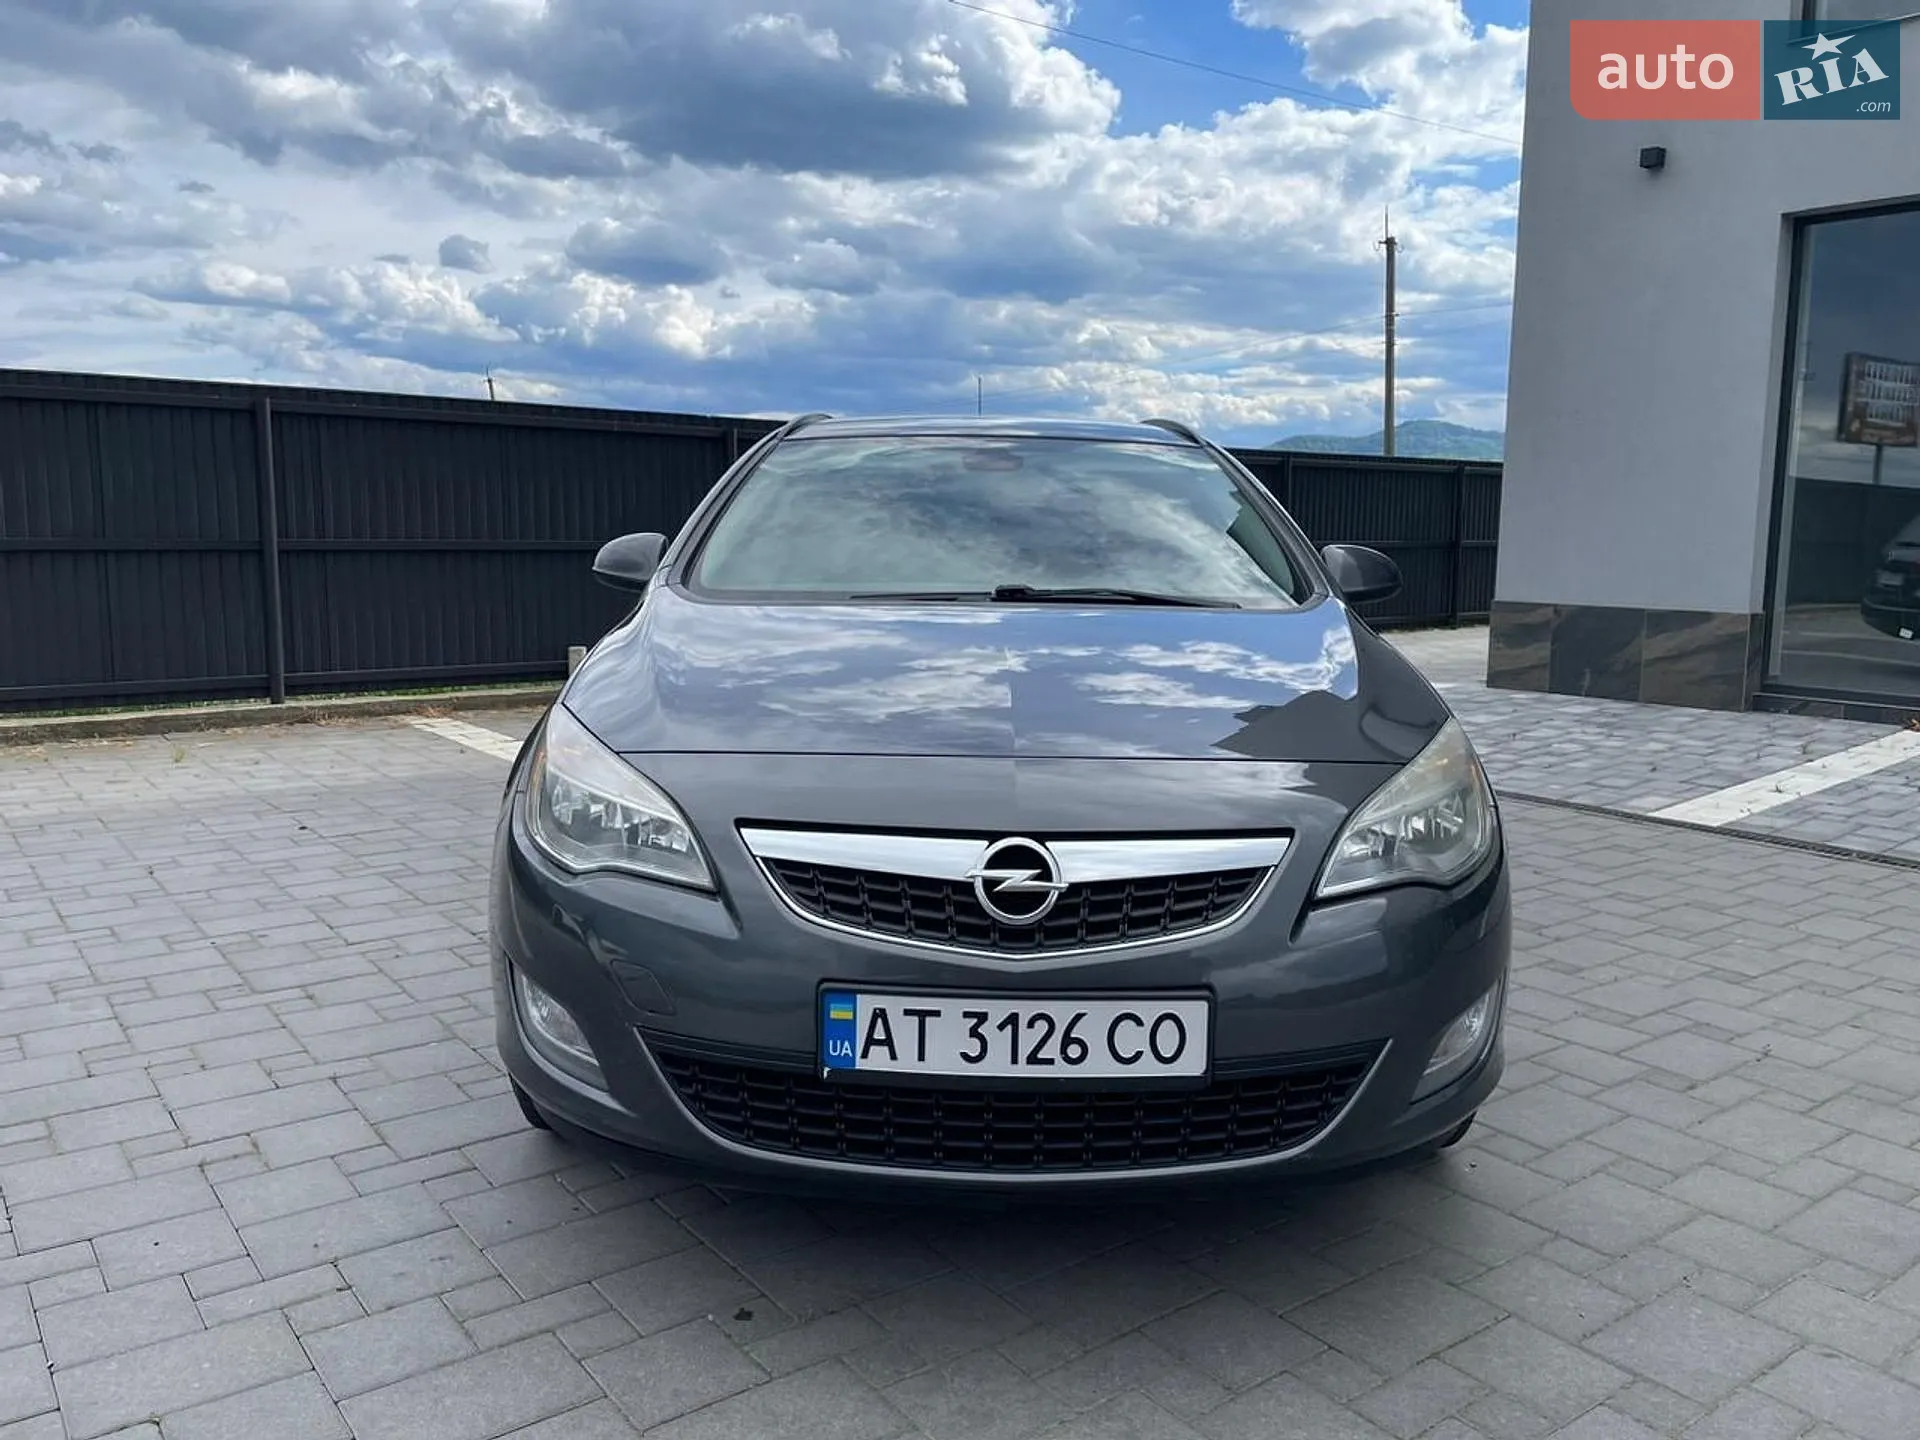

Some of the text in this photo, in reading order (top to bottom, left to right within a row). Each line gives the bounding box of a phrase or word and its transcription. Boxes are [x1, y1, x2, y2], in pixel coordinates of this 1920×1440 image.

[829, 1040, 853, 1057] UA
[860, 1008, 1187, 1066] AT 3126 CO
